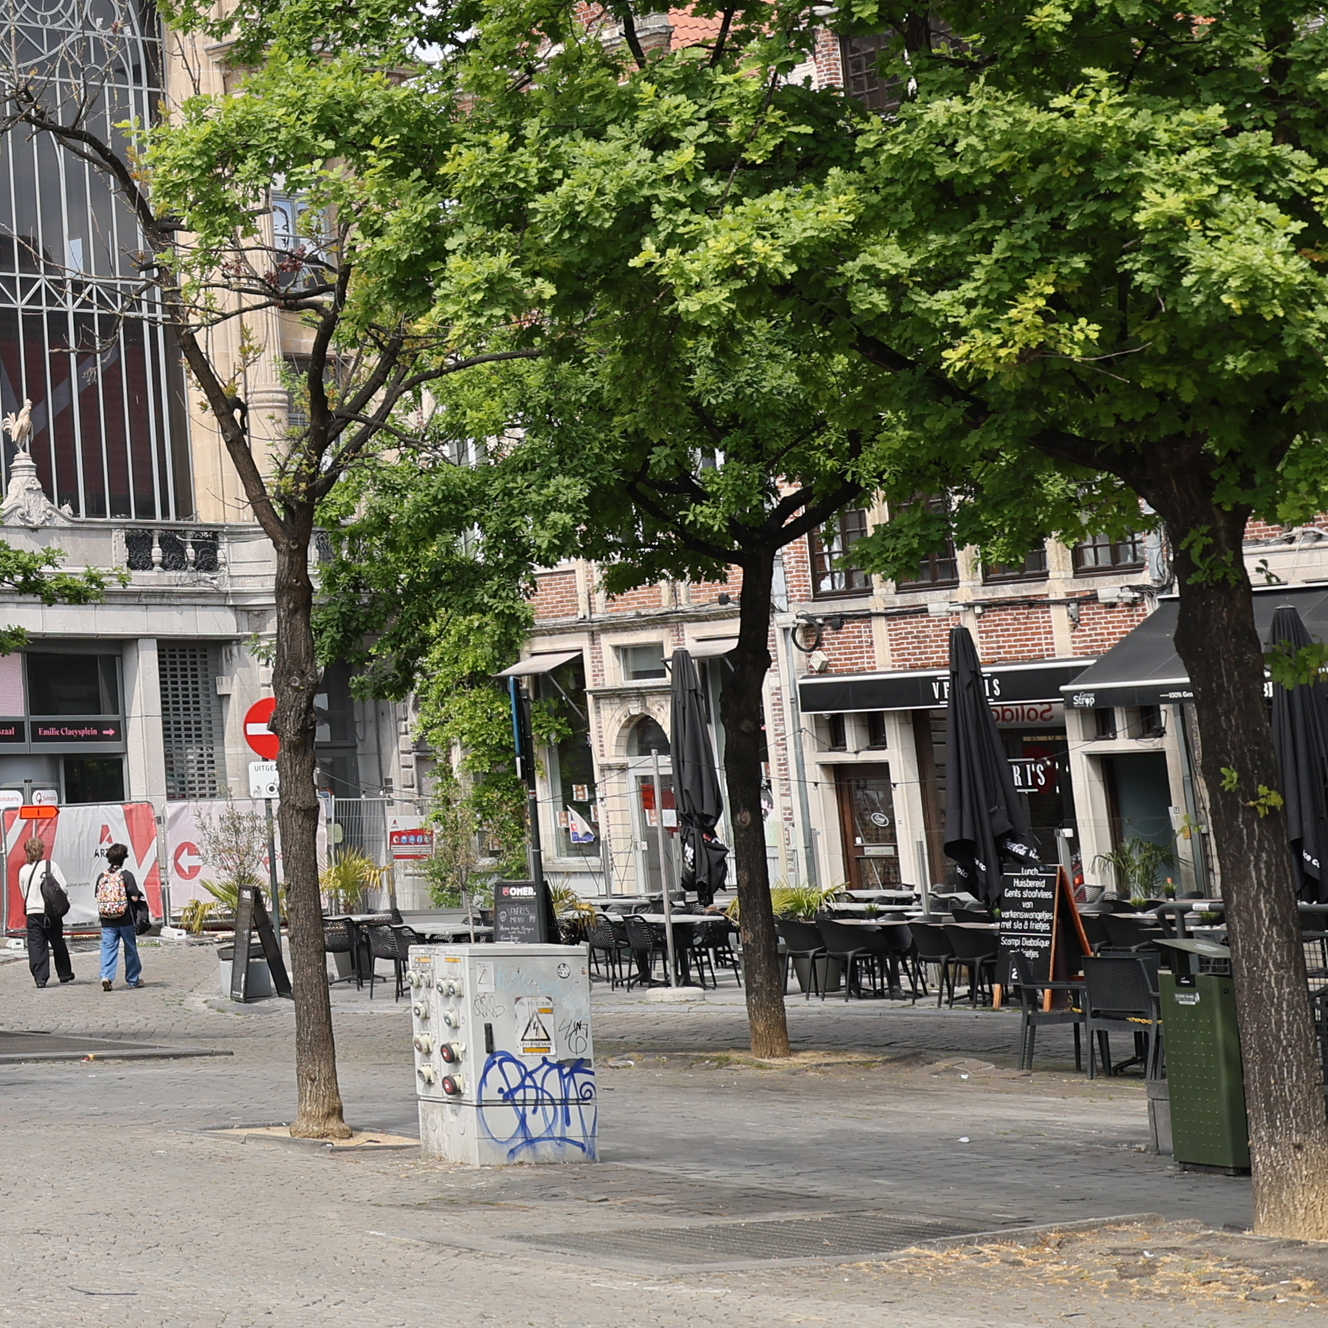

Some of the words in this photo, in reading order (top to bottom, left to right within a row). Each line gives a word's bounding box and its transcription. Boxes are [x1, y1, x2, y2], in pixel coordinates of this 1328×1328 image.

[38, 728, 59, 736] Emilie
[1021, 867, 1039, 875] Lunch
[1013, 879, 1046, 888] Huisbereid
[1001, 936, 1020, 947] Scampi
